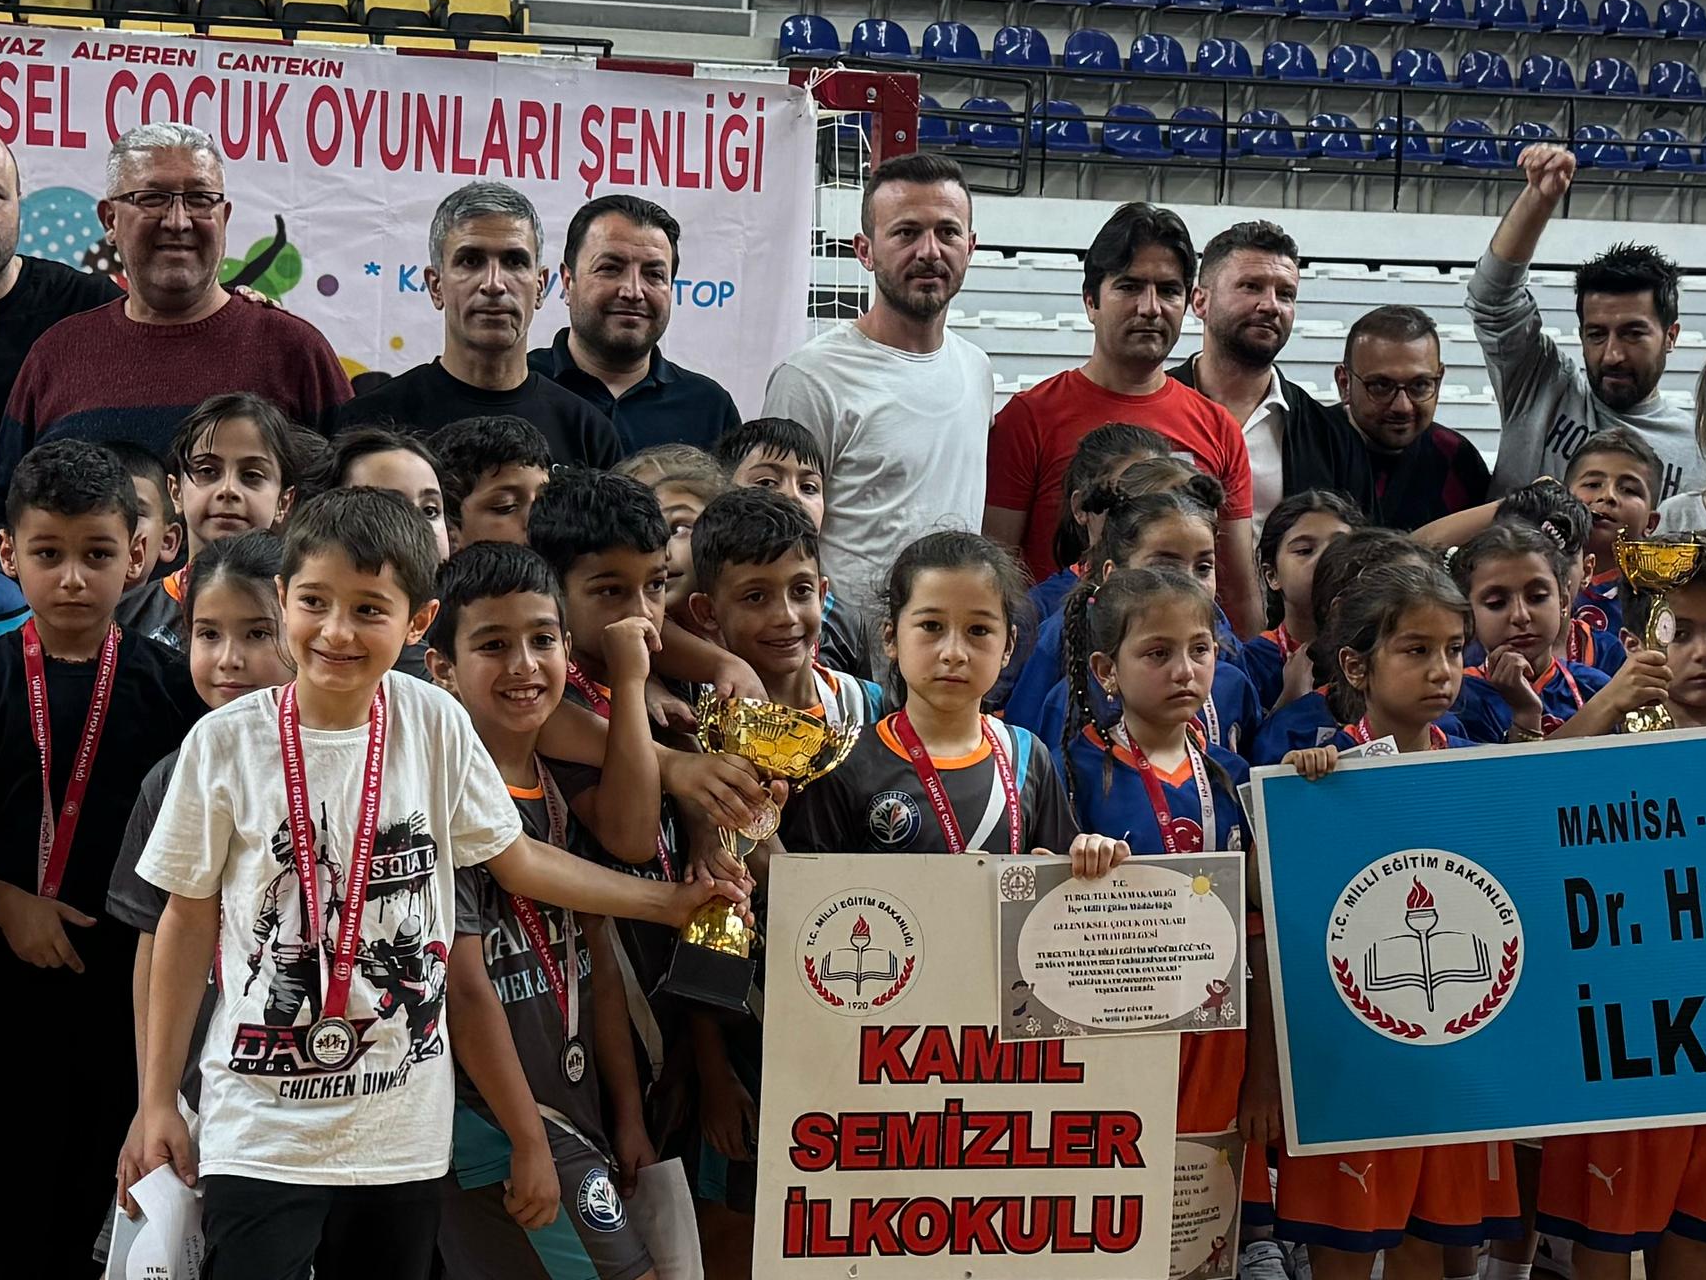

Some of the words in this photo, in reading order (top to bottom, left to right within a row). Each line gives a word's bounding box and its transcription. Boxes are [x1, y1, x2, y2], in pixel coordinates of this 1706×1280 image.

[71, 39, 197, 68] ALPEREN
[216, 50, 344, 80] CANTEKİN
[305, 85, 562, 182] OYUNLARI
[580, 90, 766, 197] ŞENLİĞİ
[1557, 789, 1686, 847] MANİSA
[815, 902, 838, 928] MİLLİ
[878, 901, 914, 947] BAKANLIĞI
[1331, 912, 1349, 941] T.C.
[1344, 869, 1379, 908] MİLLİ
[1382, 853, 1438, 877] EĞİTİM
[1445, 860, 1514, 926] BAKANLIĞI
[1563, 875, 1644, 951] Dr.
[279, 1074, 357, 1100] CHICKEN
[791, 1098, 1146, 1172] SEMİZLER
[783, 1186, 1143, 1259] İLKOKULU
